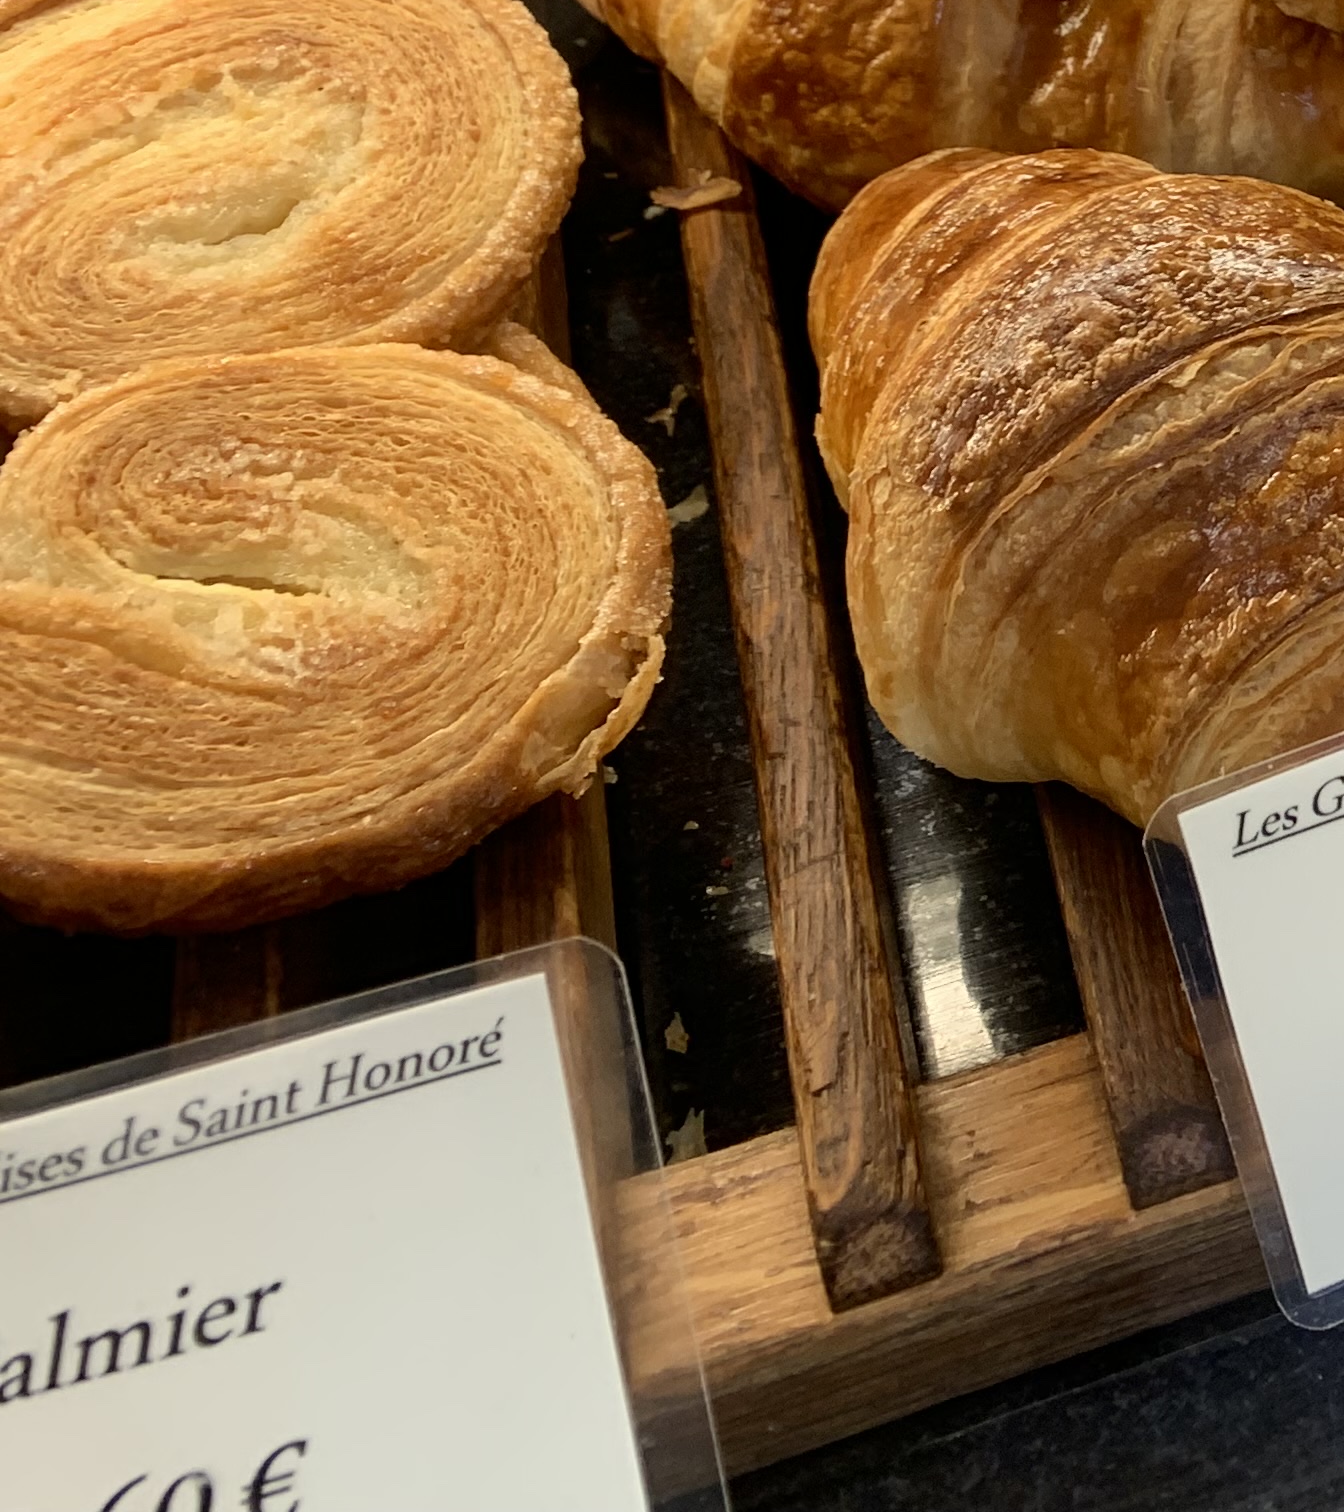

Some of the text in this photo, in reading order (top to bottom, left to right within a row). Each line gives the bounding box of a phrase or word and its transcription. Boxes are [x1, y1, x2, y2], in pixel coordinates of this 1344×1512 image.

[1233, 803, 1298, 850] Les
[101, 1116, 160, 1166] de
[172, 1078, 302, 1148] Saint
[316, 1016, 505, 1106] Honoré
